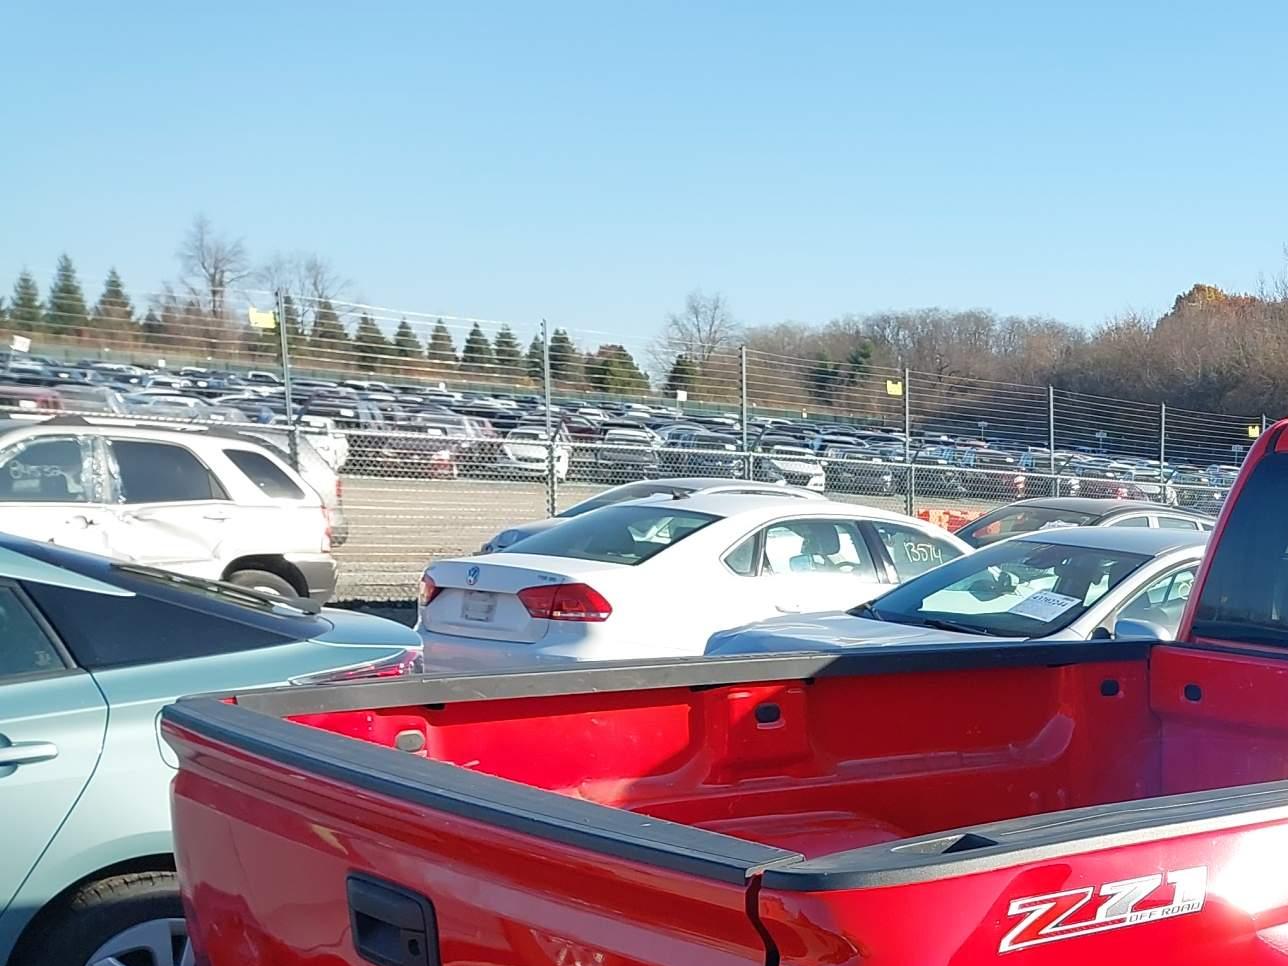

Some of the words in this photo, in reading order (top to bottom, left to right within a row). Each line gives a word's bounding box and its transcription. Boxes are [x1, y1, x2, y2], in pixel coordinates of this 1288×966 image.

[903, 542, 943, 564] 13574
[998, 865, 1208, 955] Z71
[1128, 910, 1159, 923] OFF
[1160, 900, 1201, 917] ROAD
